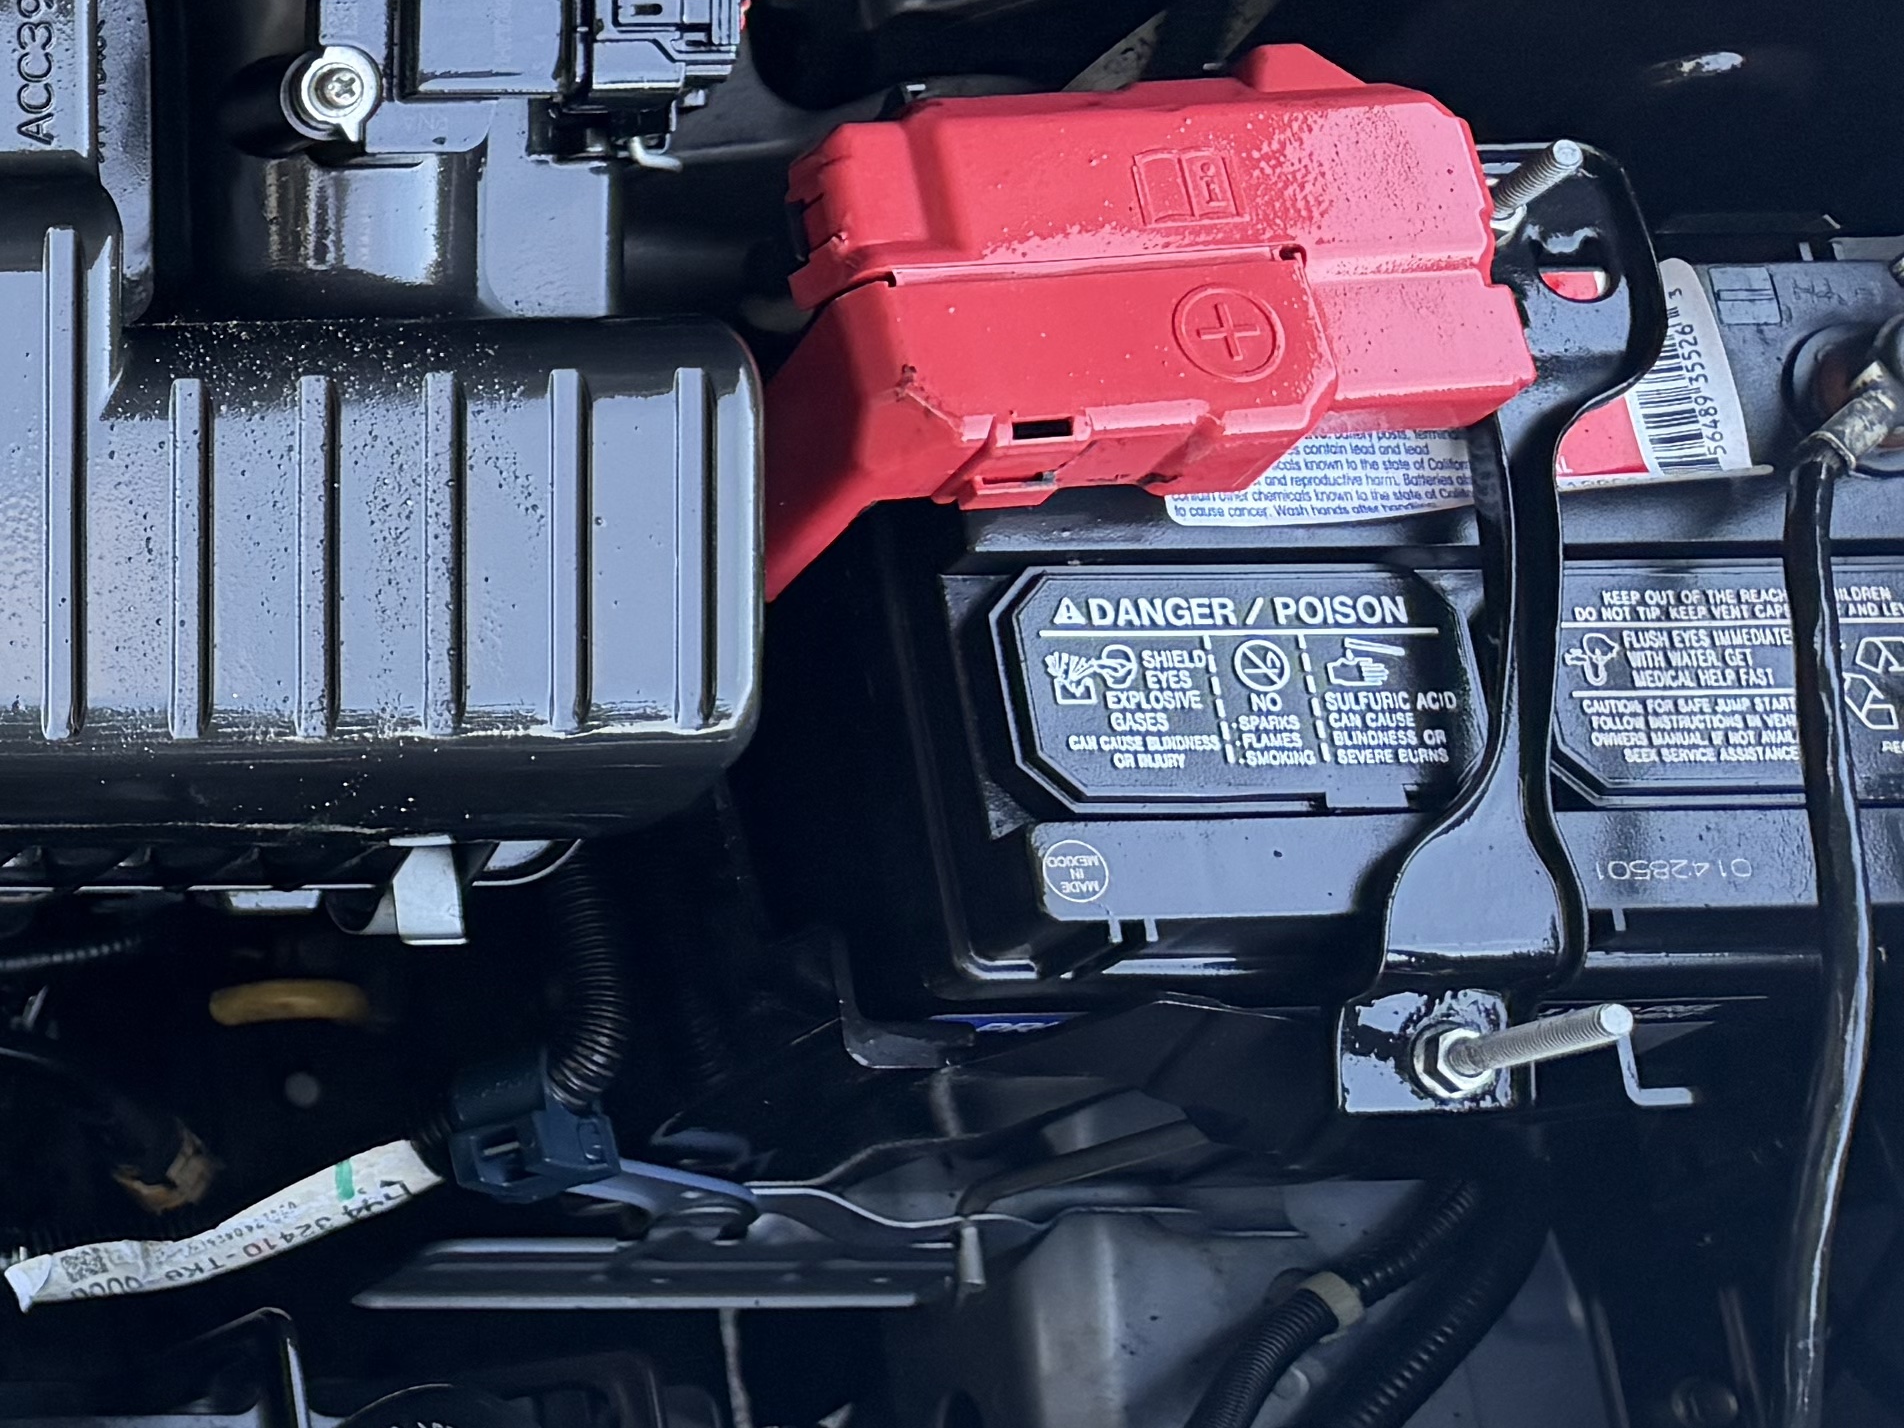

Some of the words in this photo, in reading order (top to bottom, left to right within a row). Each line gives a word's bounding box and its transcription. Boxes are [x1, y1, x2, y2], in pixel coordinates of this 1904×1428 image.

[1677, 323, 1709, 385] 35526
[1698, 394, 1727, 456] 56489
[1304, 459, 1343, 471] known
[1346, 459, 1358, 471] to
[1360, 458, 1379, 470] the
[1382, 458, 1411, 471] state
[1413, 458, 1425, 470] of
[1264, 474, 1288, 486] and
[1290, 474, 1363, 489] reproductive
[1403, 473, 1452, 487] Batteries
[1251, 489, 1312, 502] chemicals
[1314, 488, 1354, 502] known
[1174, 506, 1186, 518] to
[1190, 507, 1225, 518] cause
[1275, 503, 1310, 517] Wash
[1312, 502, 1350, 516] hands
[1601, 589, 1640, 606] KEEP
[1644, 589, 1677, 605] OUT
[1681, 589, 1701, 604] OF
[1705, 588, 1737, 604] THE
[1740, 588, 1789, 603] REACH
[1088, 597, 1237, 626] DANGER
[1245, 596, 1264, 625] /
[1272, 595, 1409, 625] POISON
[1574, 607, 1597, 622] DO
[1601, 606, 1632, 621] NOT
[1669, 605, 1706, 620] KEEP
[1710, 604, 1750, 620] VENT
[1848, 602, 1879, 617] AND
[1622, 630, 1669, 649] FLUSH
[1672, 629, 1710, 648] EYES
[1142, 650, 1206, 668] SHIELD
[1626, 650, 1666, 668] WITH
[1724, 648, 1753, 666] GET
[1145, 670, 1192, 689] EYES
[1632, 670, 1697, 688] MEDICAL
[1698, 669, 1736, 687] HELP
[1740, 668, 1775, 686] FAST
[1106, 690, 1203, 709] EXPLOSIVE
[1250, 693, 1283, 712] NO
[1324, 691, 1411, 712] SULFURIC
[1416, 691, 1458, 711] ACID
[1646, 699, 1675, 713] FOR
[1677, 699, 1710, 713] SAFE
[1714, 699, 1751, 712] JUMP
[1110, 713, 1169, 732] GASES
[1238, 715, 1301, 731] SPARKS
[1328, 712, 1363, 729] CAN
[1365, 712, 1415, 728] CAUSE
[1068, 735, 1098, 751] CAN
[1099, 735, 1145, 751] CAUSE
[1242, 733, 1303, 749] FLAMES
[1333, 730, 1418, 747] BLINDNESS
[1423, 729, 1447, 745] OR
[1729, 730, 1755, 745] NOT
[1113, 753, 1135, 769] OR
[1245, 750, 1317, 766] SMOKING
[1336, 748, 1394, 765] SEVERE
[1398, 748, 1450, 764] BURNS
[1661, 747, 1717, 762] SERVICE
[1046, 854, 1099, 868] MEXICO
[1069, 867, 1085, 880] IN
[1060, 880, 1100, 893] MADE
